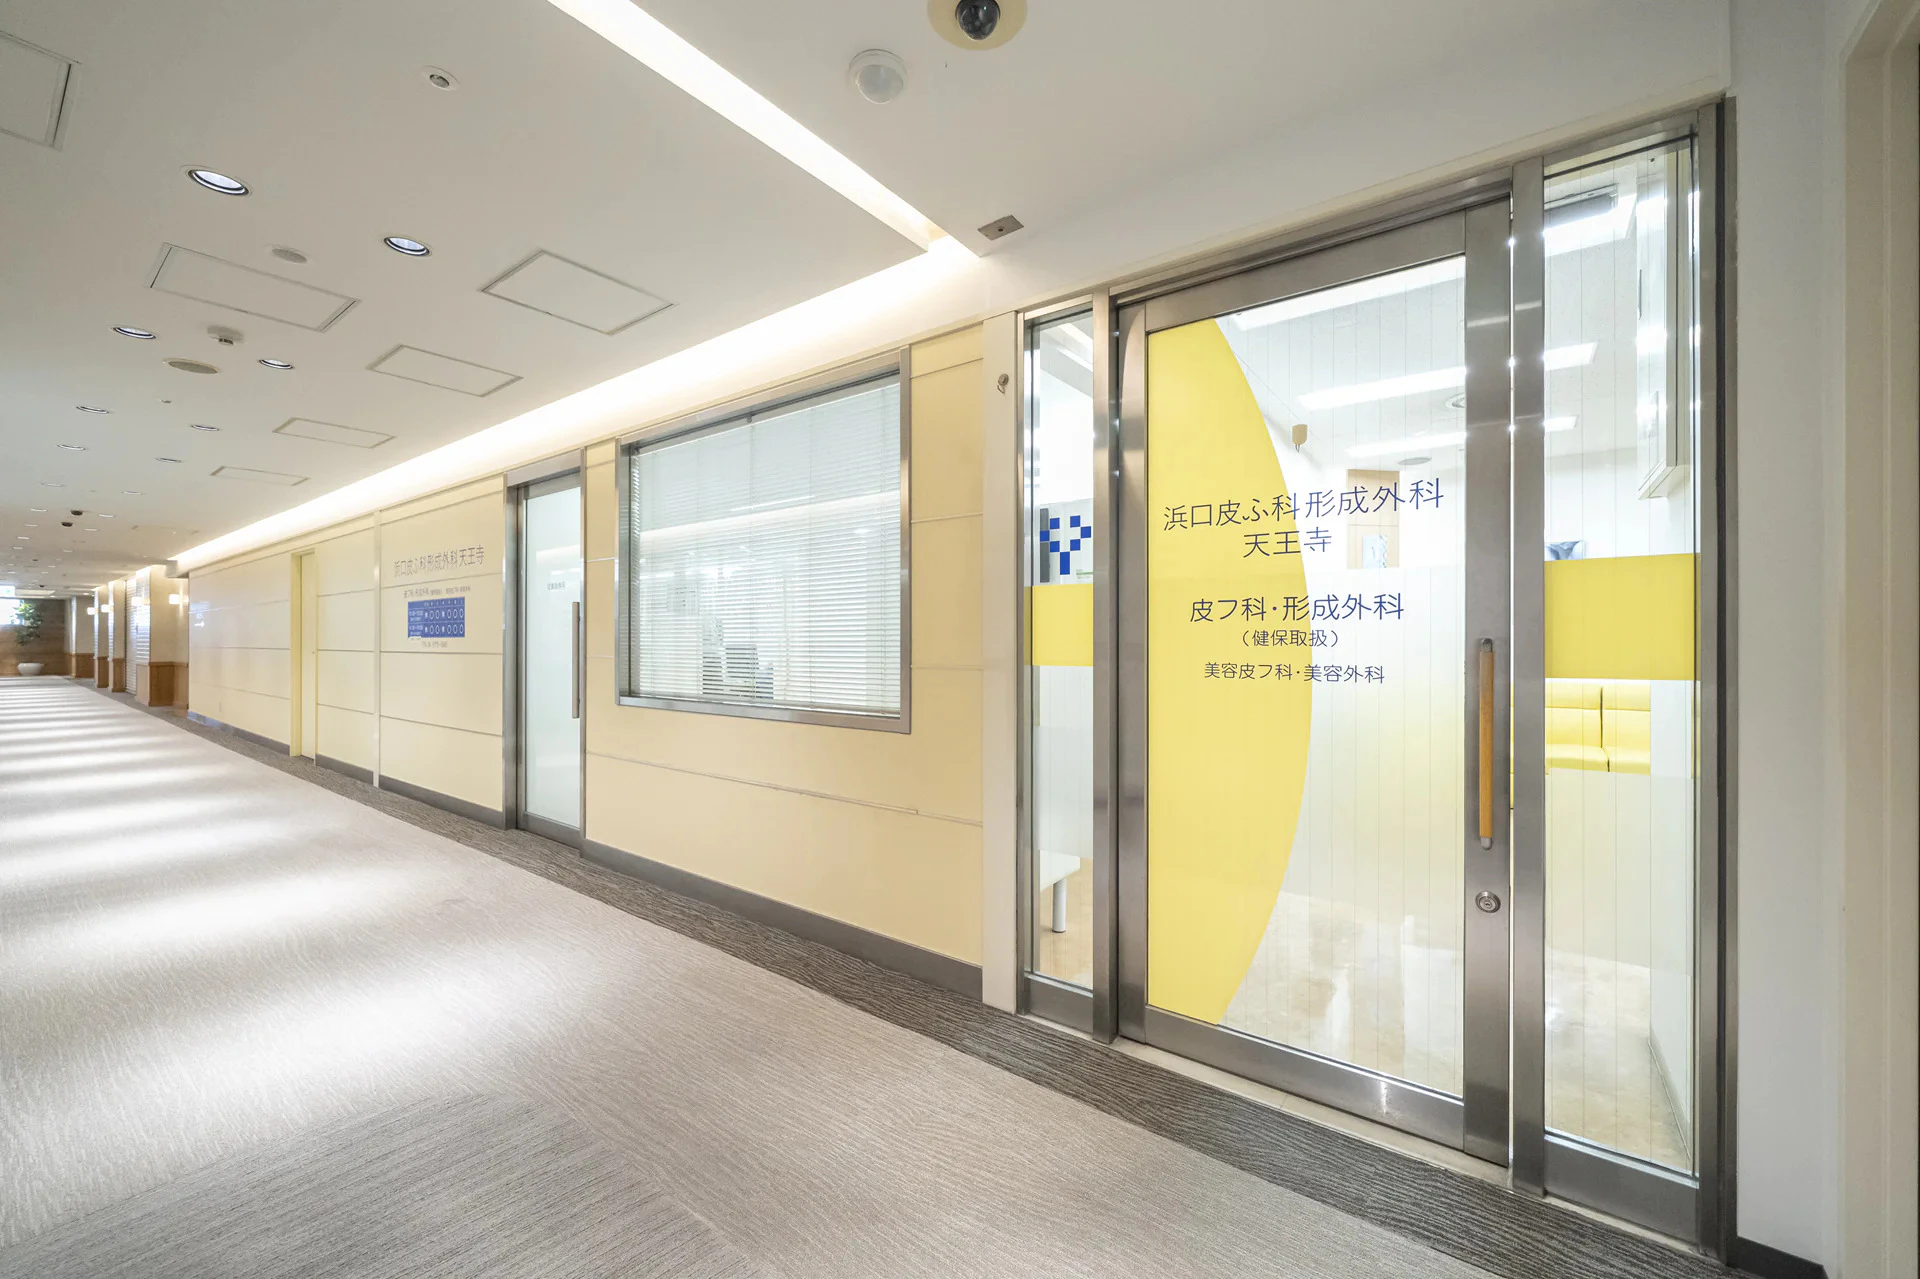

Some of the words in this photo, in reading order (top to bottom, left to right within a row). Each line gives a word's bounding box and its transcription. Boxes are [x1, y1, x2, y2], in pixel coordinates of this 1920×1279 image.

[1163, 477, 1445, 531] 浜口皮ふ科形成外科
[1243, 526, 1332, 558] 天王寺
[1190, 592, 1405, 623] 皮フ科・形成外科
[1204, 662, 1386, 684] 美容皮フ科・美容外科
